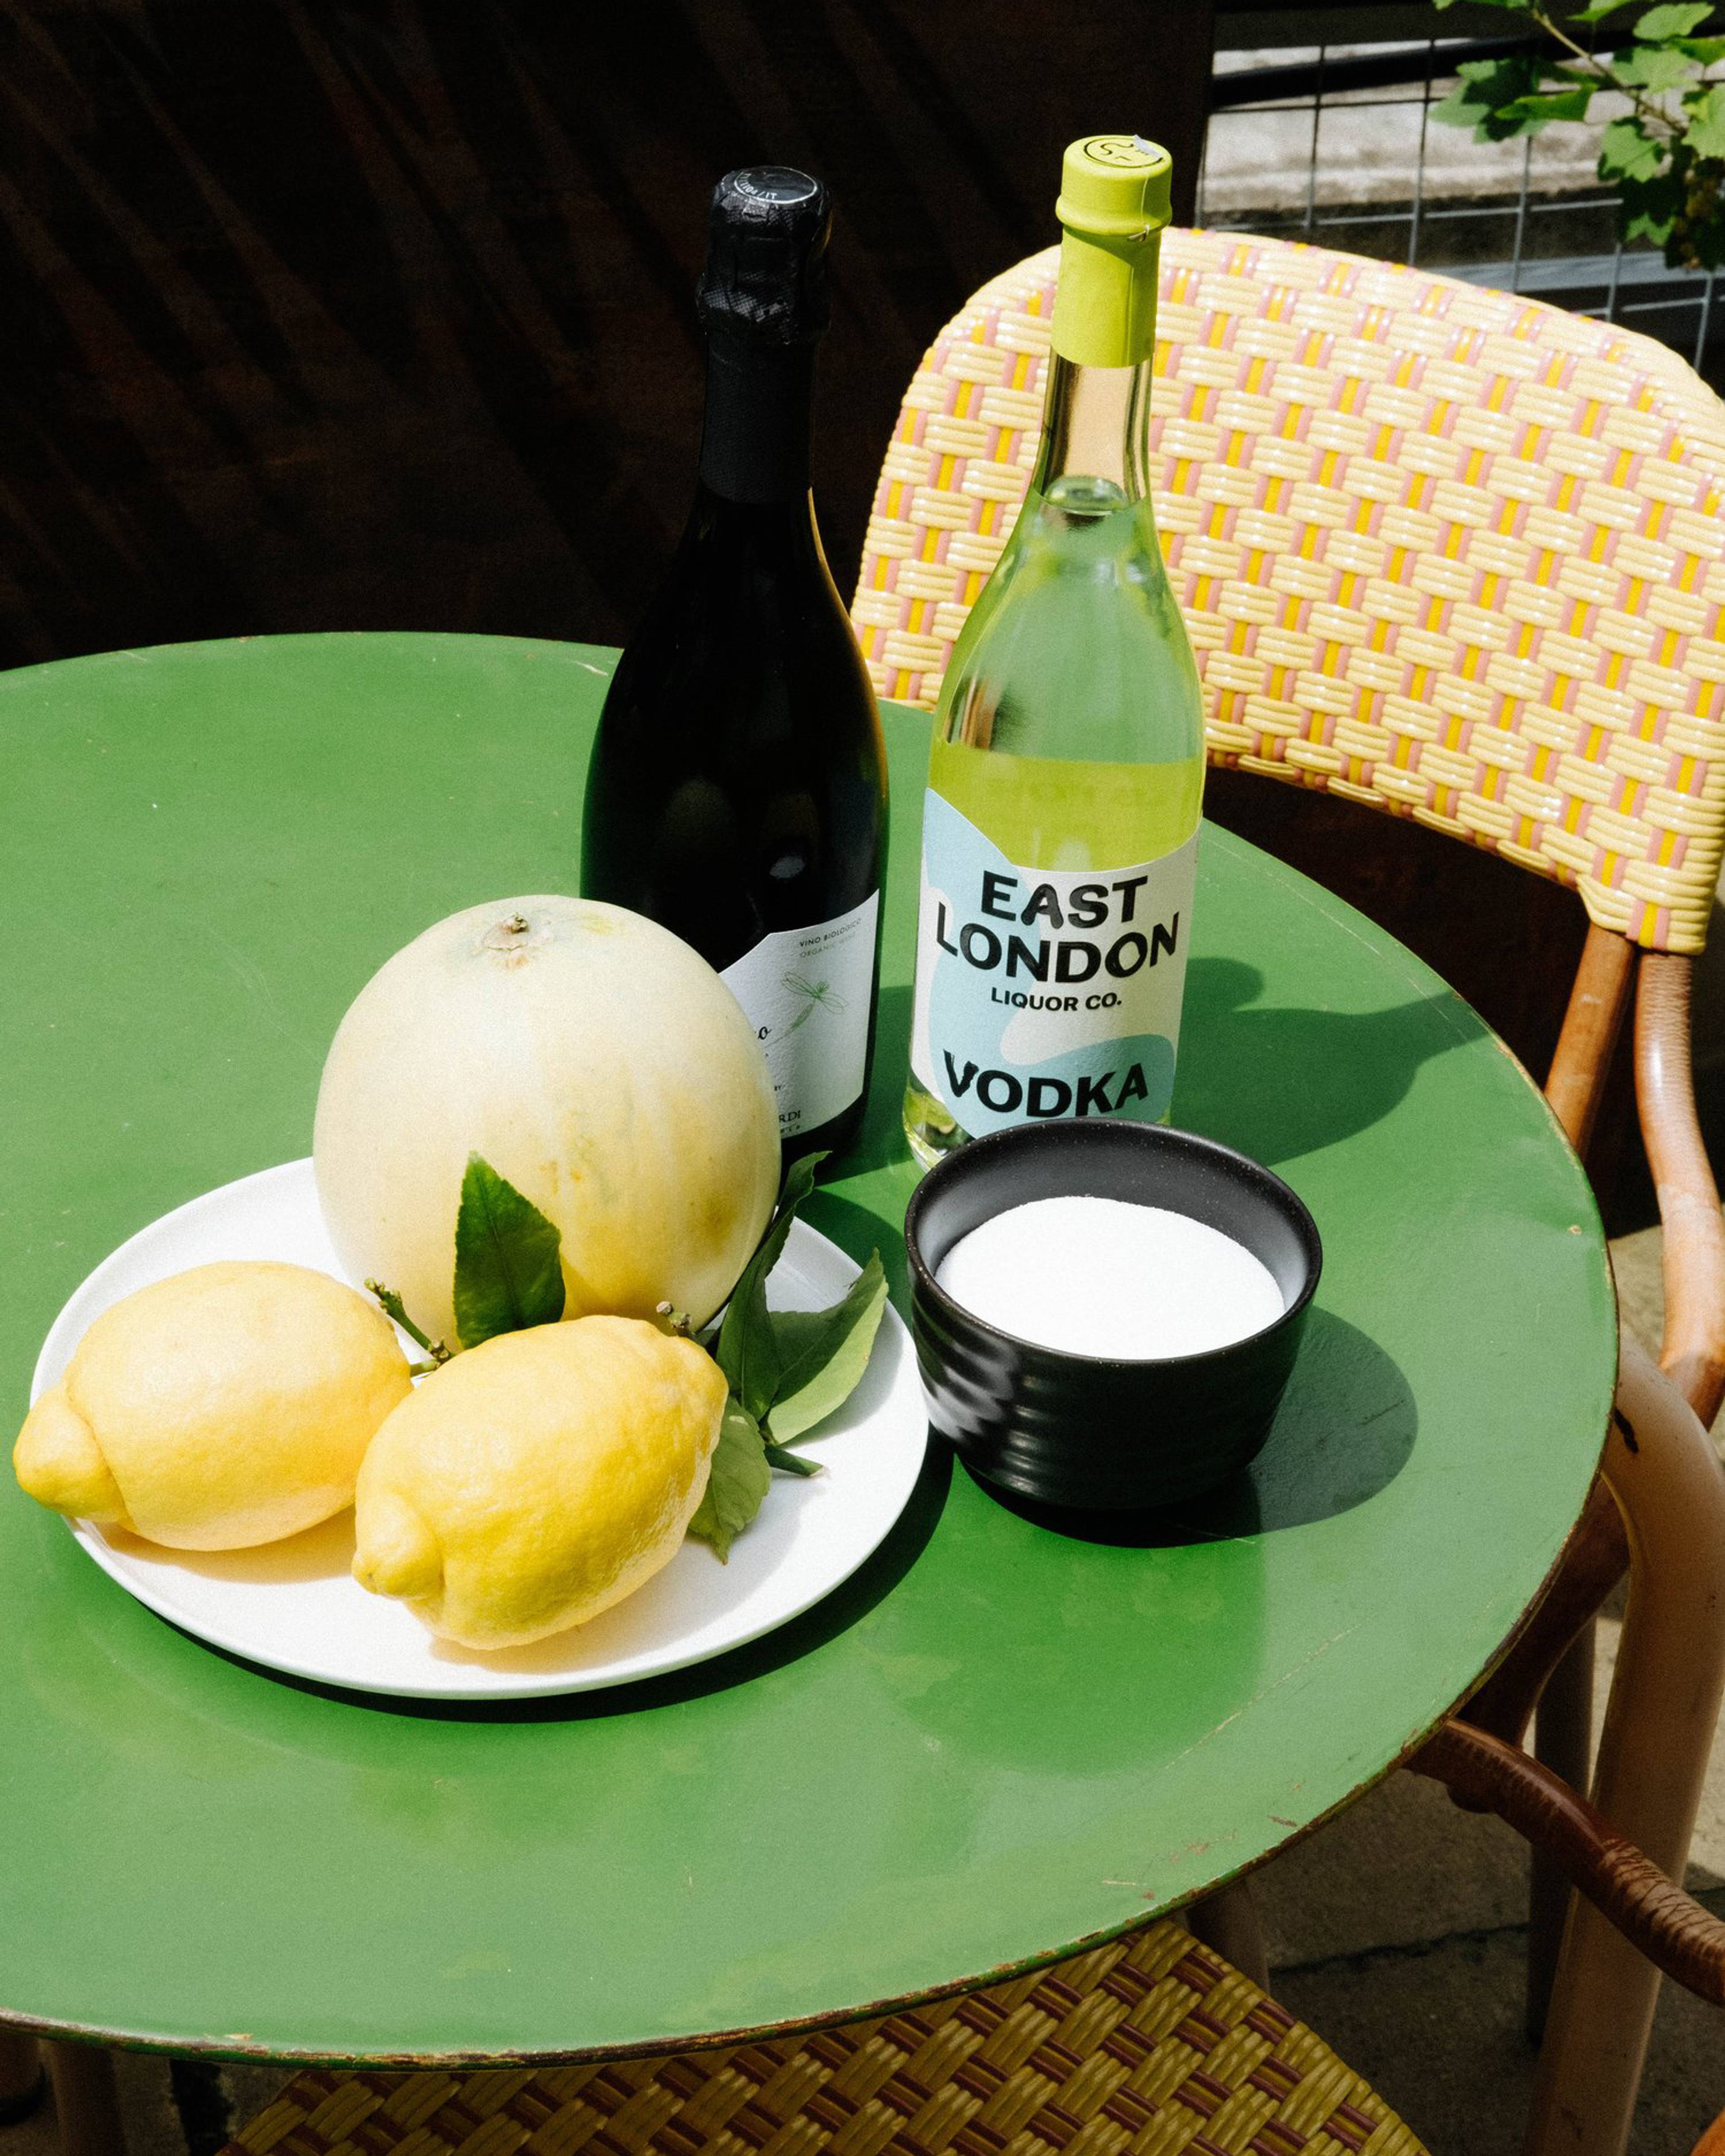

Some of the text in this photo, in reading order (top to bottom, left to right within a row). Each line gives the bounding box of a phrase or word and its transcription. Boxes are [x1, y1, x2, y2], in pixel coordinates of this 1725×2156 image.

[981, 870, 1148, 929] EAST
[799, 918, 861, 947] VINO BIOLOGICO
[936, 901, 1179, 983] LONDON
[991, 987, 1122, 1012] LIQUOR CO.
[943, 1048, 1149, 1118] VODKA
